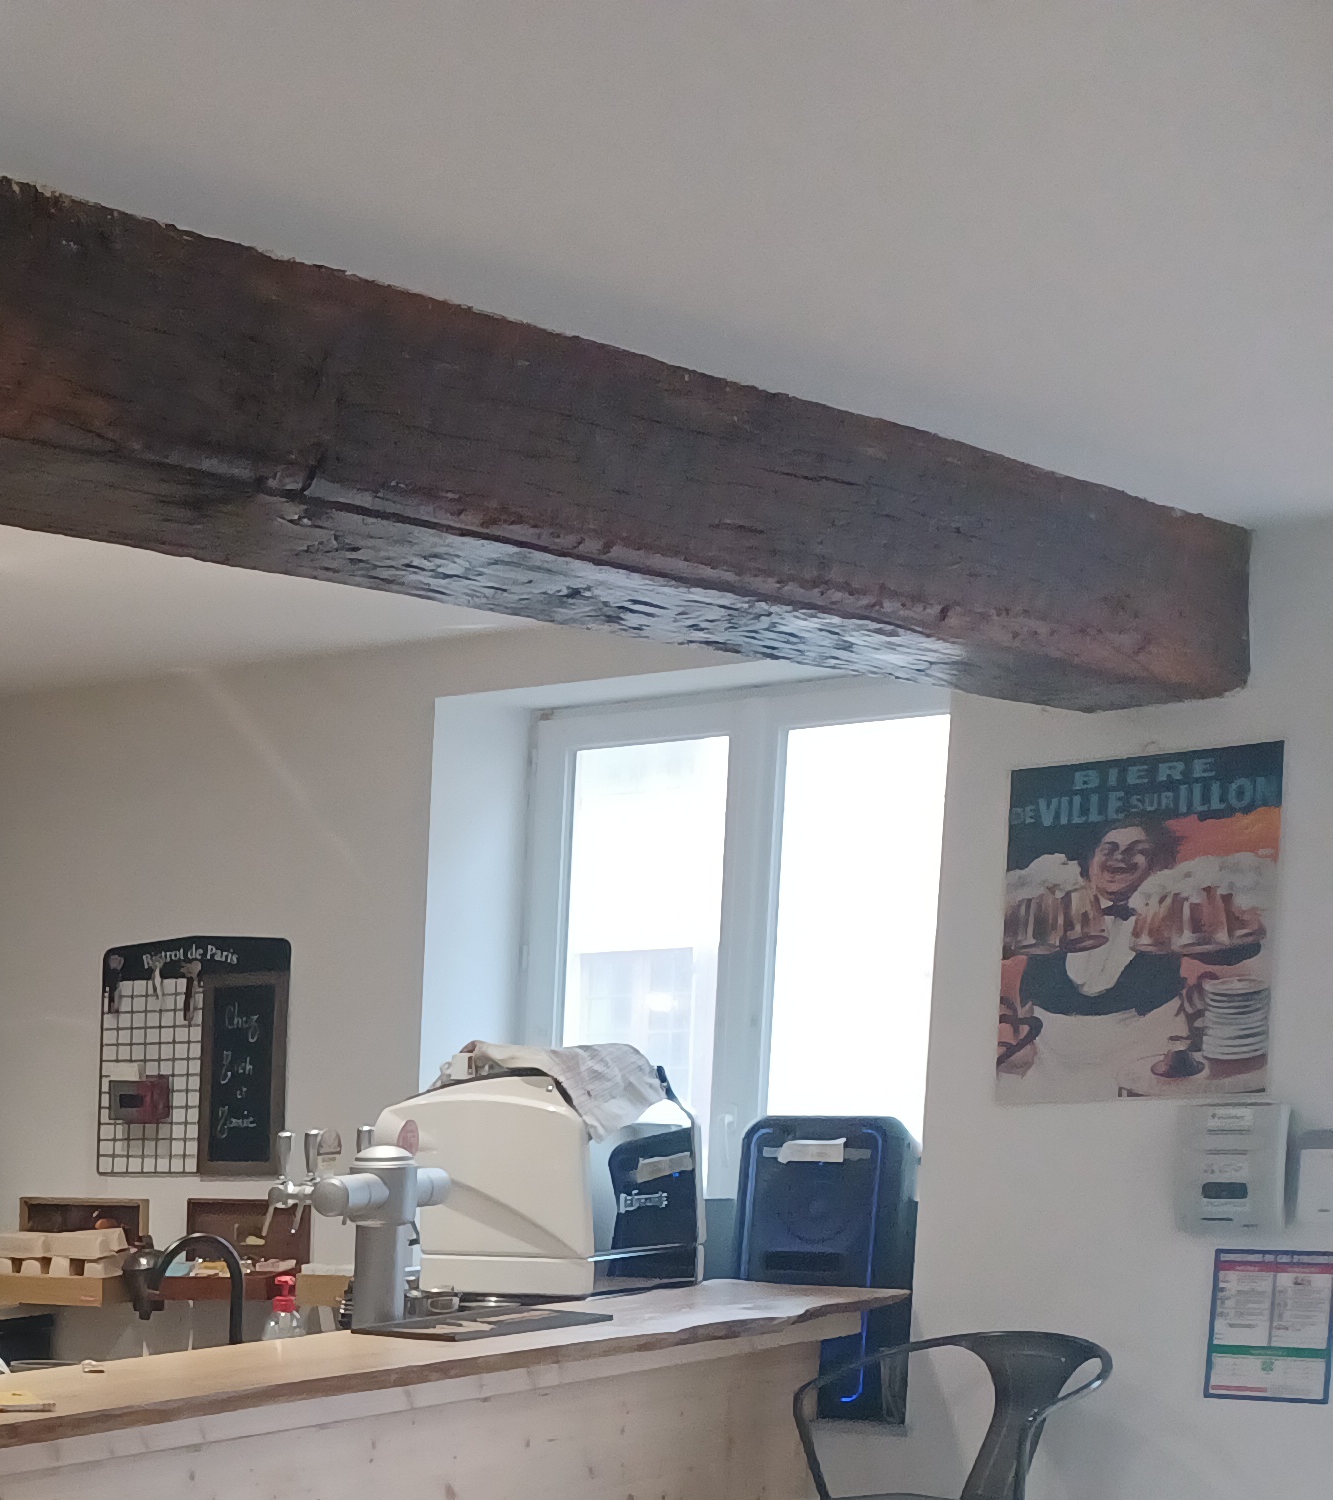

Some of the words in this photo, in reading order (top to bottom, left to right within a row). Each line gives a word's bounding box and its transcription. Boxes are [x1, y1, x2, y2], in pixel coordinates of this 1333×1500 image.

[1072, 757, 1217, 790] BIERE
[1010, 804, 1037, 826] DE
[1038, 790, 1126, 827] VILLE
[1130, 791, 1175, 812] SUR
[1178, 774, 1282, 815] ILLON
[142, 947, 185, 969] Btrot
[187, 943, 204, 959] de
[206, 944, 239, 965] Paris
